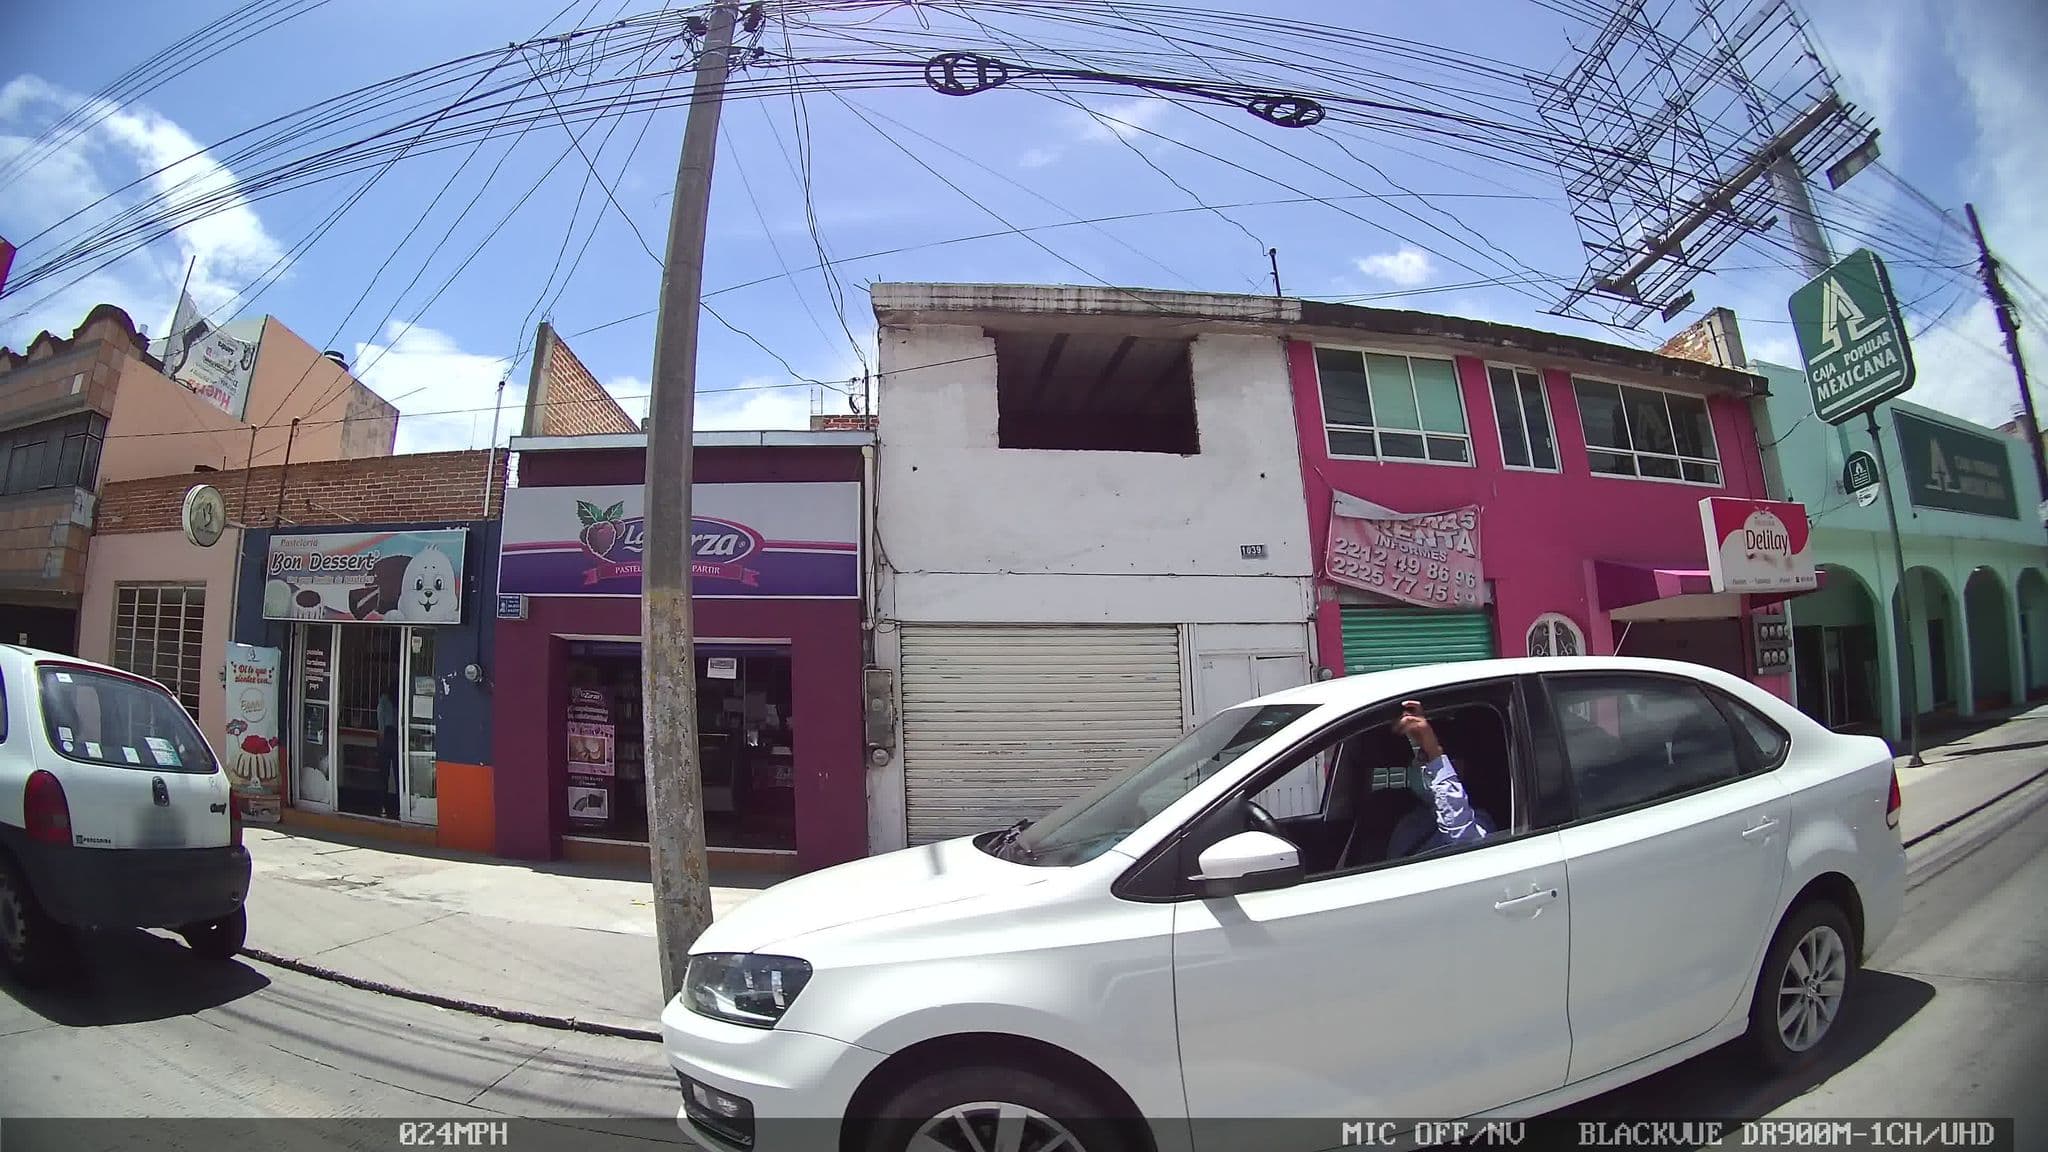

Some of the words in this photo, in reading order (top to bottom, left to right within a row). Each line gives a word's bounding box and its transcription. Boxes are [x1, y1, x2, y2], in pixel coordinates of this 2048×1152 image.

[1812, 362, 1837, 382] CAJA
[1843, 331, 1892, 366] POPULAR
[1817, 348, 1898, 402] MEXICANA
[691, 533, 739, 556] rza
[1375, 535, 1448, 563] INFORMES
[1377, 519, 1476, 558] RENTA
[1745, 529, 1788, 556] Delilay
[271, 552, 303, 575] Bon
[615, 564, 644, 575] PASTEL
[692, 564, 721, 575] PARTIR
[1334, 537, 1388, 568] 2212
[1394, 555, 1421, 575] 49
[1427, 562, 1450, 582] 86
[1454, 571, 1476, 588] 96
[1332, 556, 1385, 586] 2225
[1391, 574, 1419, 595] 77
[1424, 583, 1449, 602] 15
